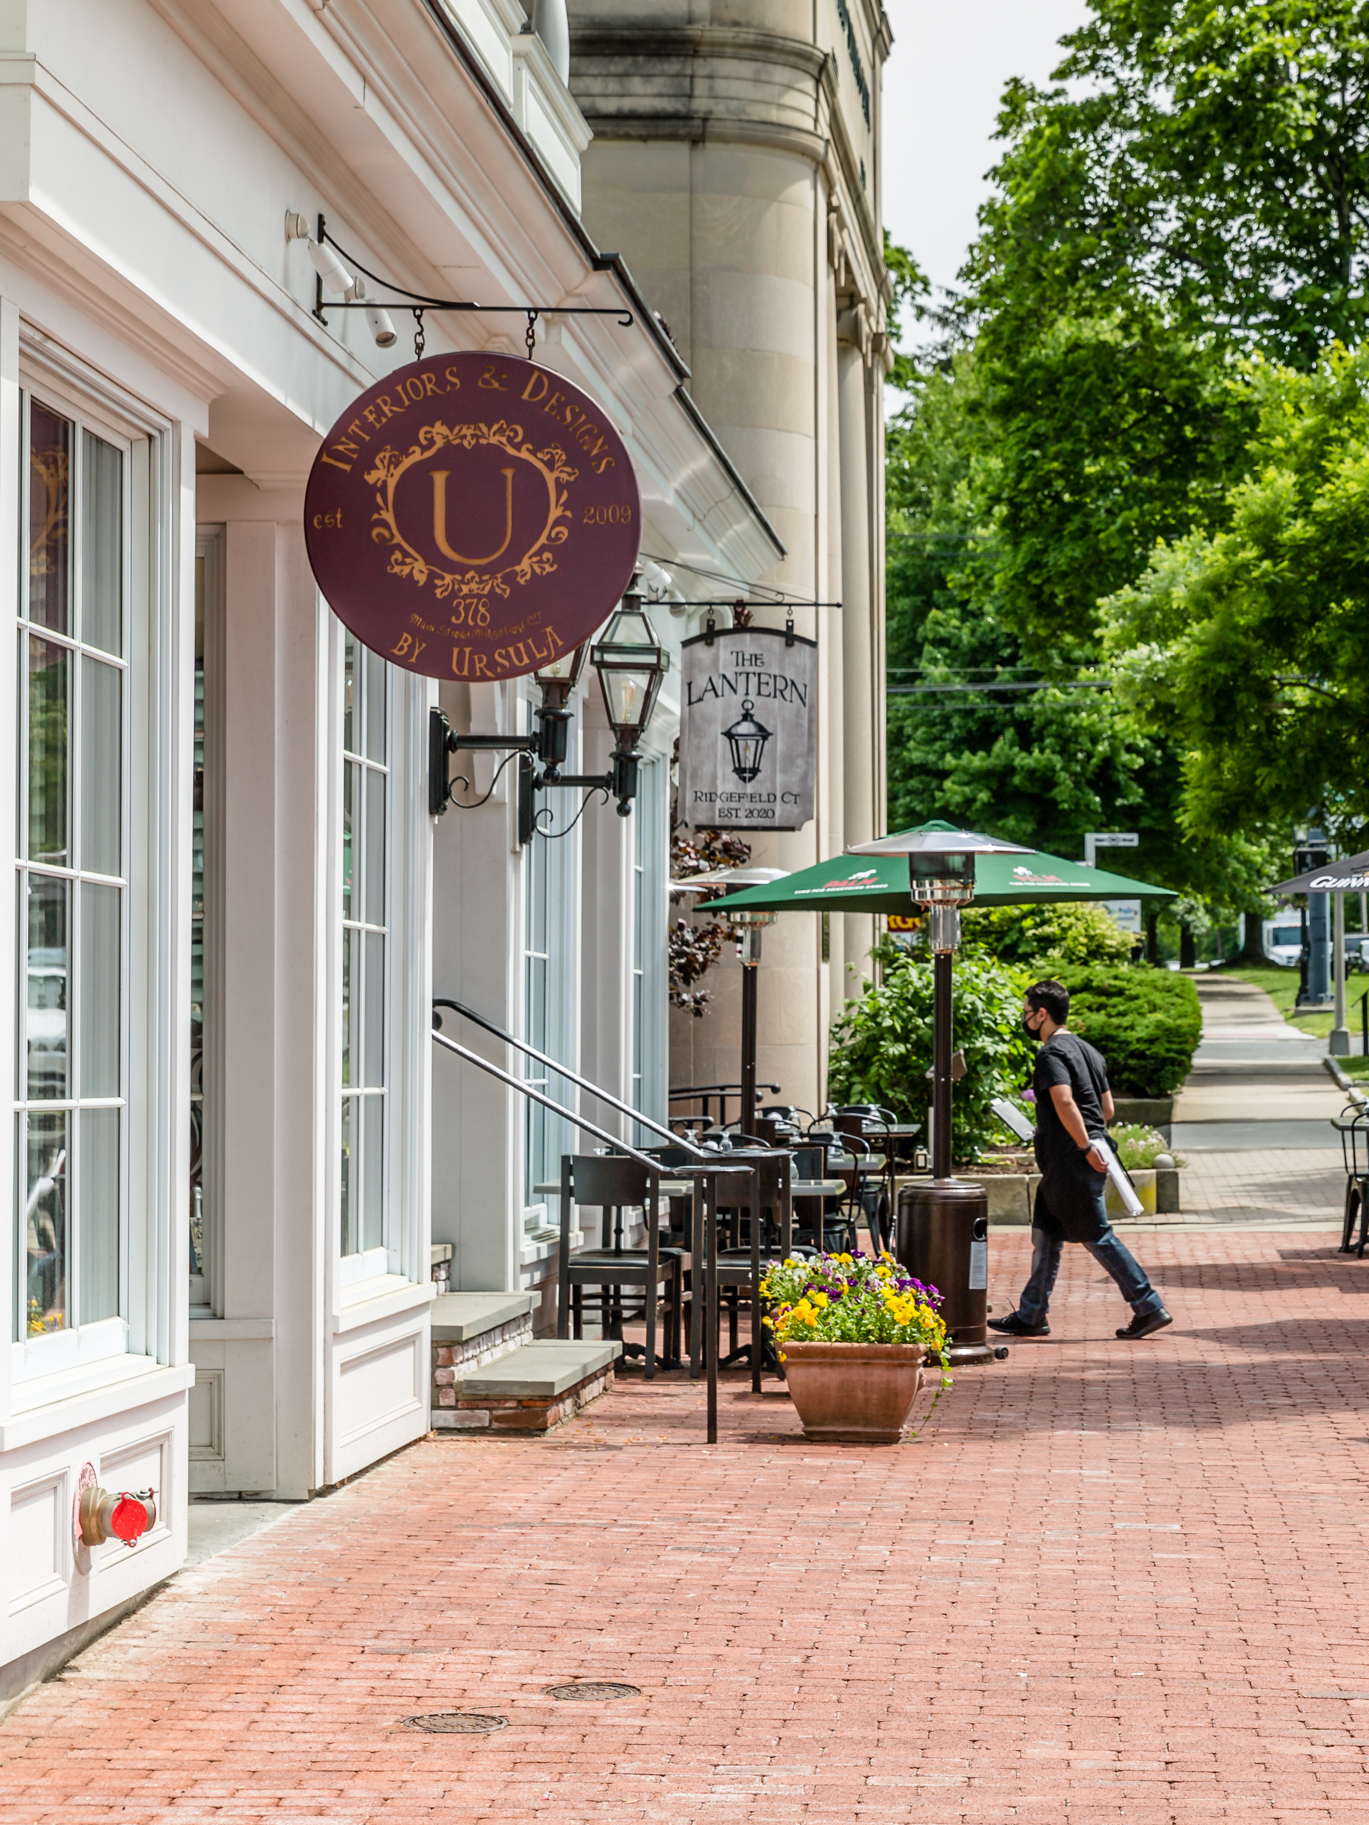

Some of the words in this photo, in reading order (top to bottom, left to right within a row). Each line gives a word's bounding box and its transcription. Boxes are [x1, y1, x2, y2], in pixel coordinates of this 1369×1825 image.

[320, 366, 461, 474] INTERIORS
[478, 365, 511, 391] &
[521, 368, 616, 475] DESIGNS
[313, 508, 344, 529] est
[583, 505, 632, 525] 2009
[427, 467, 517, 566] U
[451, 598, 490, 627] 378
[391, 631, 427, 663] BY
[452, 625, 565, 678] URSULA
[730, 650, 765, 668] THE
[686, 671, 808, 708] LANTERN
[693, 790, 777, 804] RIDGEFIELD
[781, 791, 800, 804] CT
[718, 807, 741, 819] EST.
[744, 807, 775, 819] 2020
